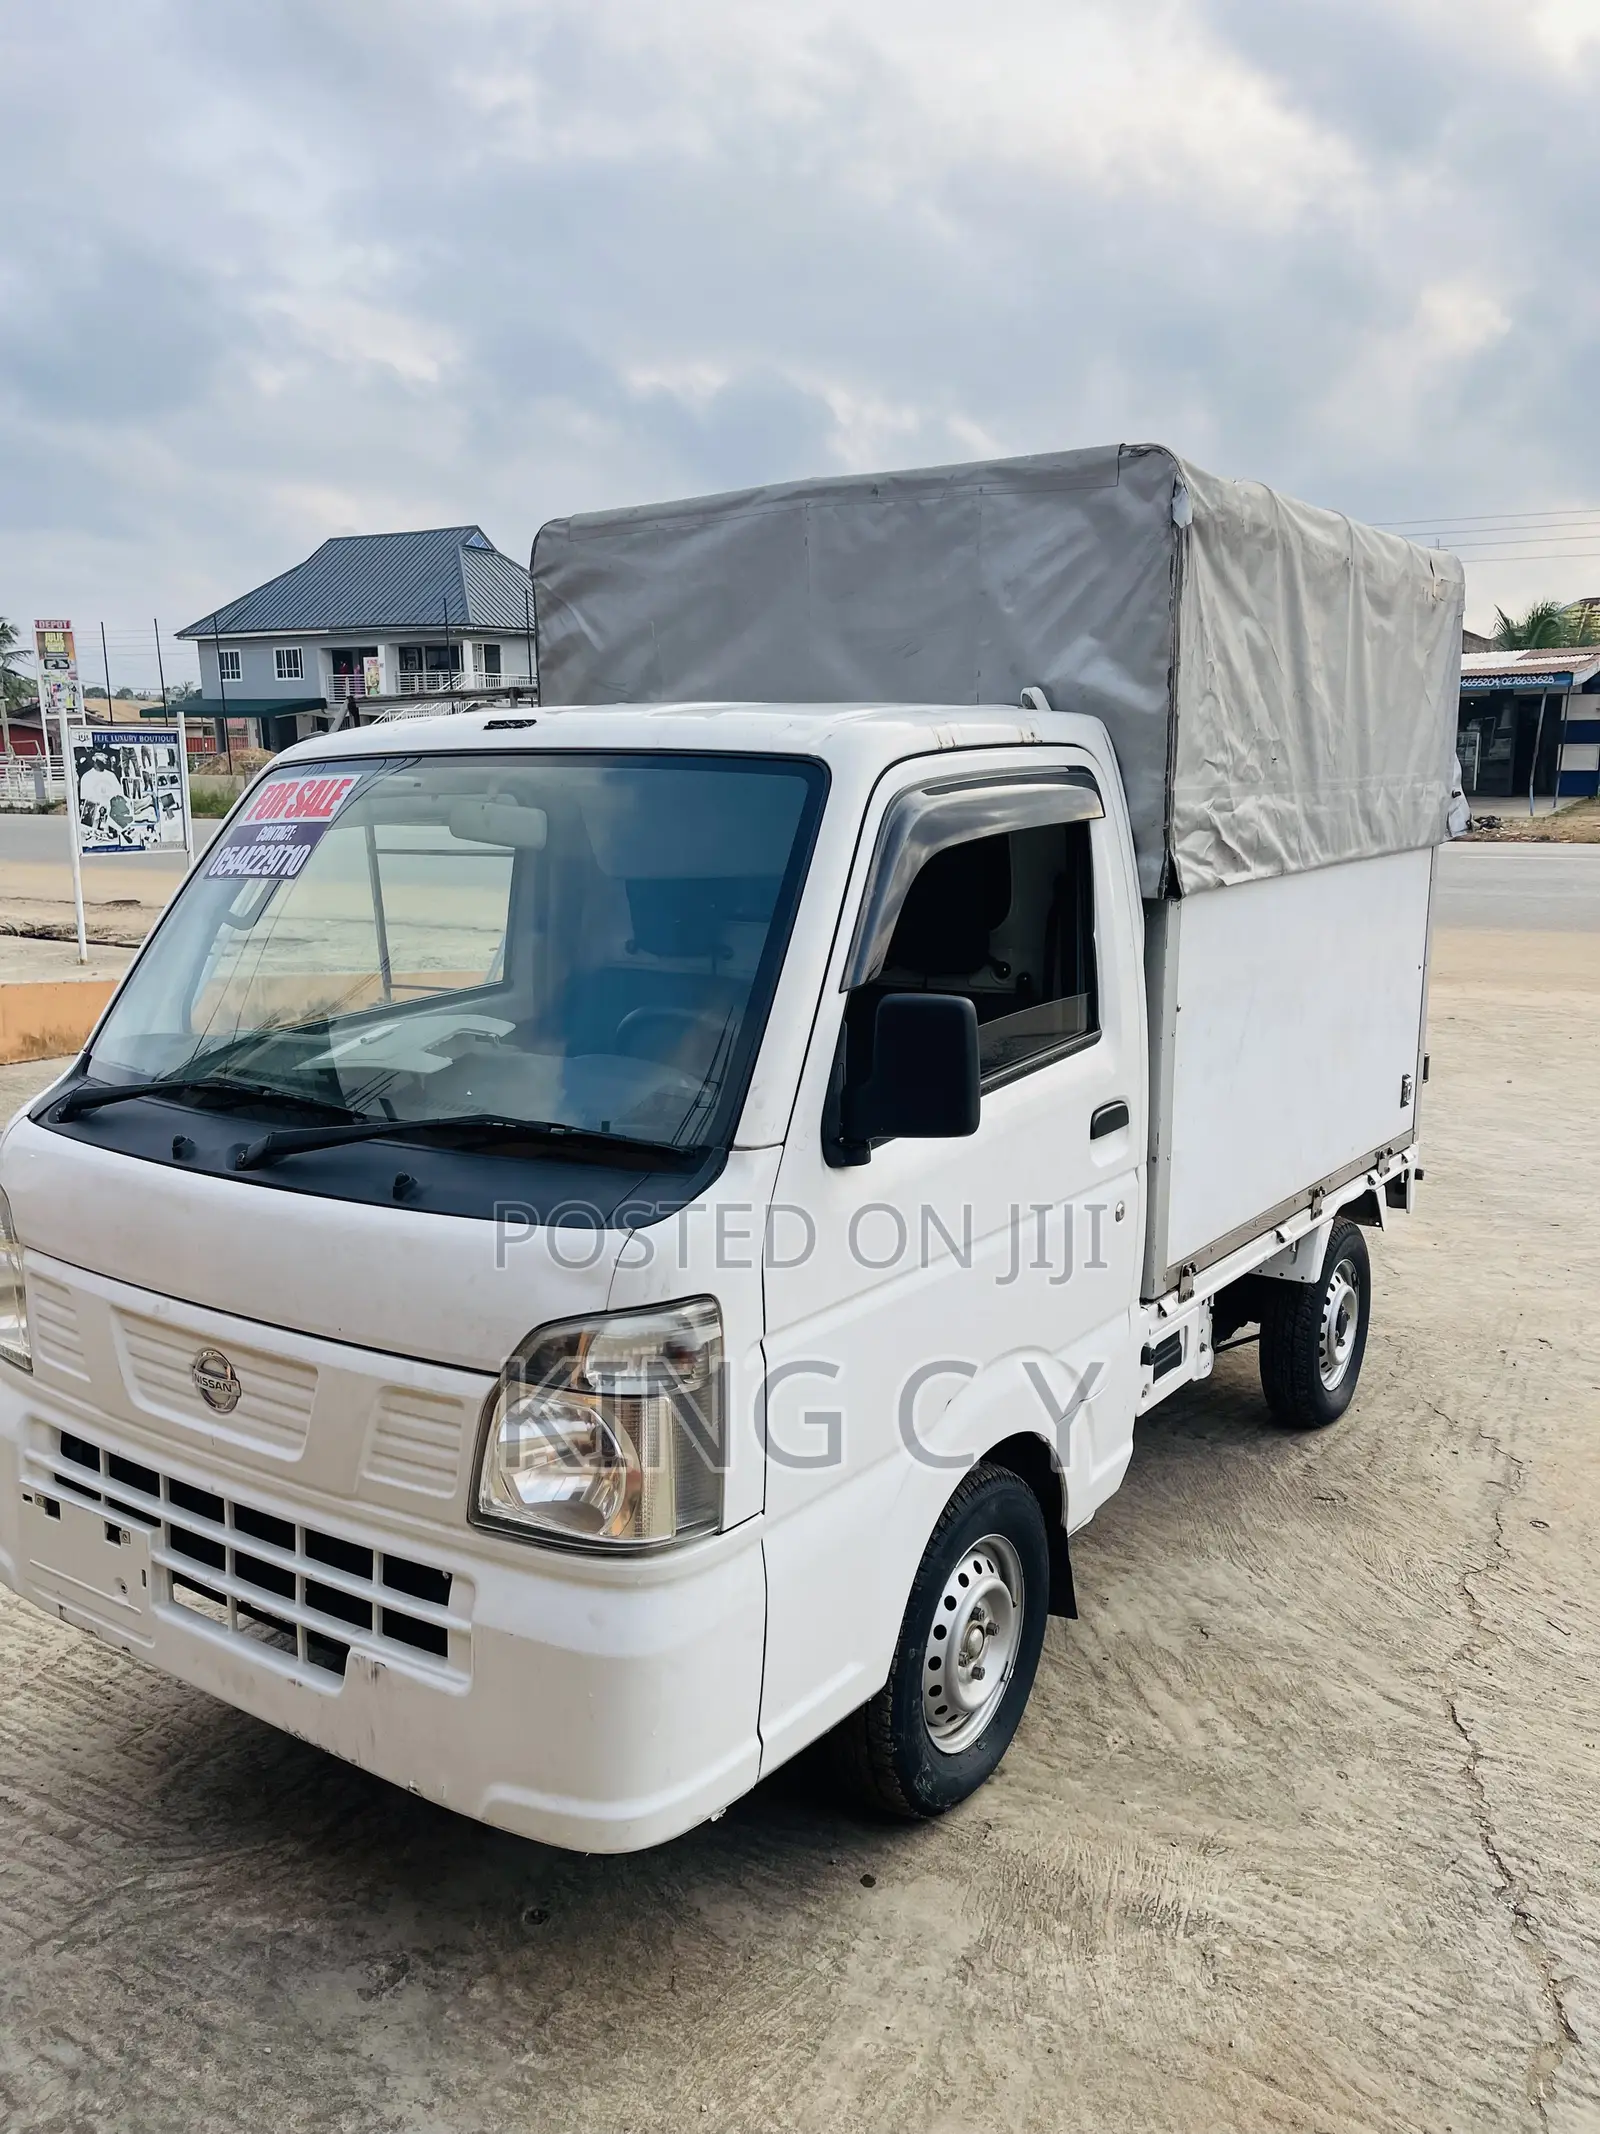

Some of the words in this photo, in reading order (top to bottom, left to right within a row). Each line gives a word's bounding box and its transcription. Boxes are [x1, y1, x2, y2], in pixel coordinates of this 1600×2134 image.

[39, 620, 68, 629] DEPOT
[111, 734, 137, 743] LUXURY
[139, 735, 175, 743] BOUTIQUE
[245, 781, 299, 821] FOR
[285, 778, 355, 819] SALE
[256, 824, 298, 842] CONTACT:
[208, 844, 312, 877] 0544229710
[194, 1373, 232, 1393] NISSAN
